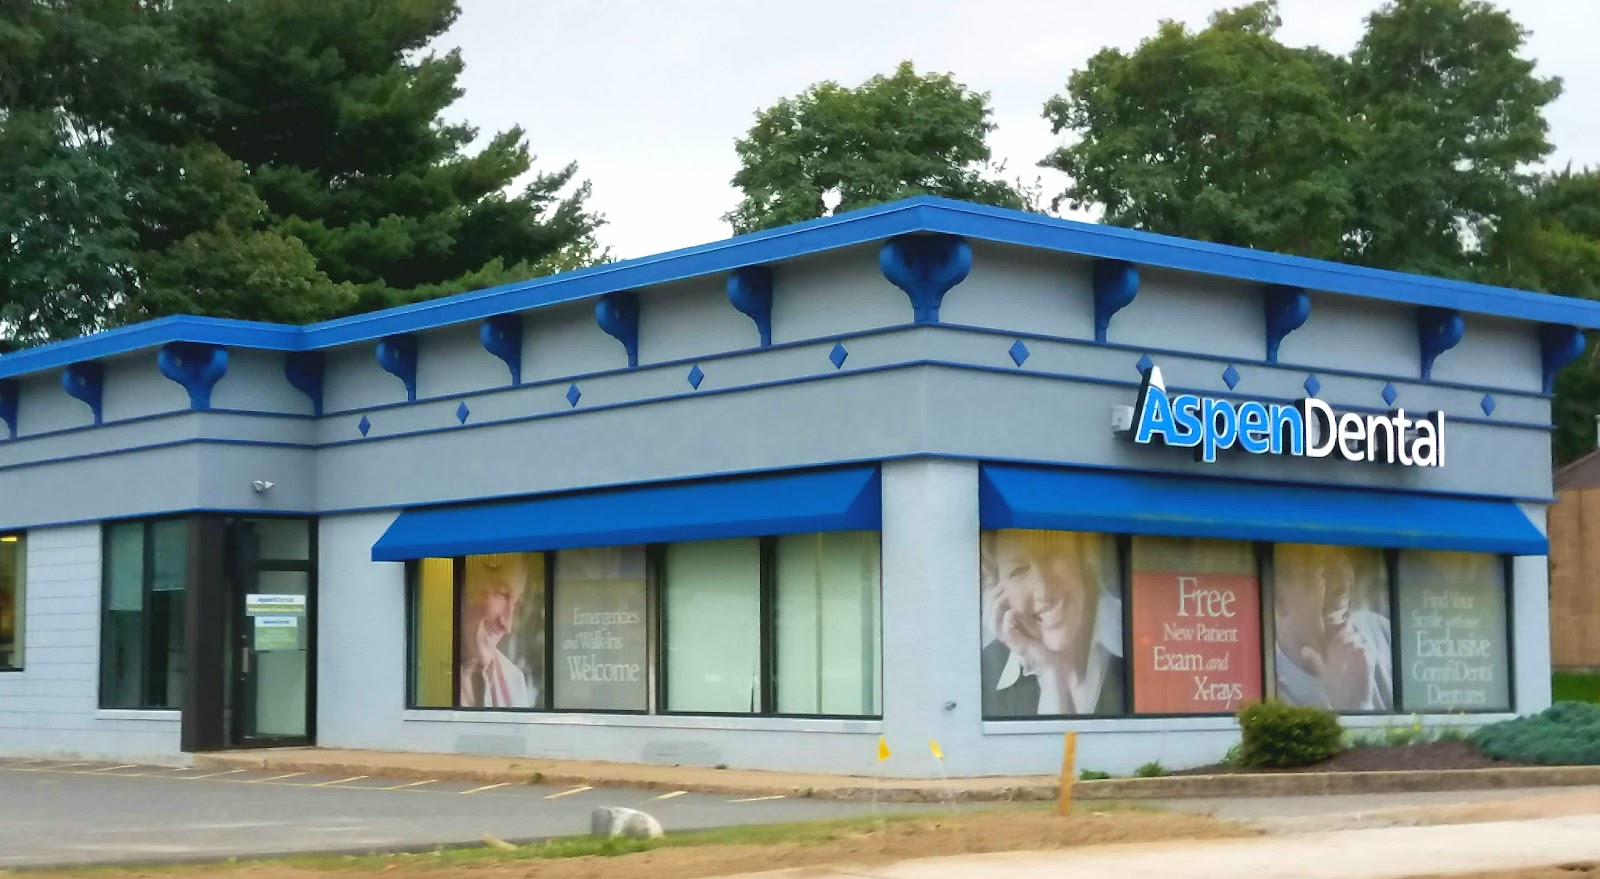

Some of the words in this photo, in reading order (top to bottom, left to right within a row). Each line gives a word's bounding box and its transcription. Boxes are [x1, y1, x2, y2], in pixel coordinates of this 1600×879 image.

[1176, 576, 1237, 619] Free
[573, 607, 640, 631] Emergencies
[1163, 622, 1194, 641] New
[1197, 622, 1239, 642] Patient
[1417, 629, 1491, 658] Exclusive
[566, 653, 640, 682] Welcome
[1153, 645, 1203, 672] Exam
[1205, 651, 1230, 671] and
[1193, 675, 1243, 710] X-rays
[1427, 684, 1487, 706] Dentures
